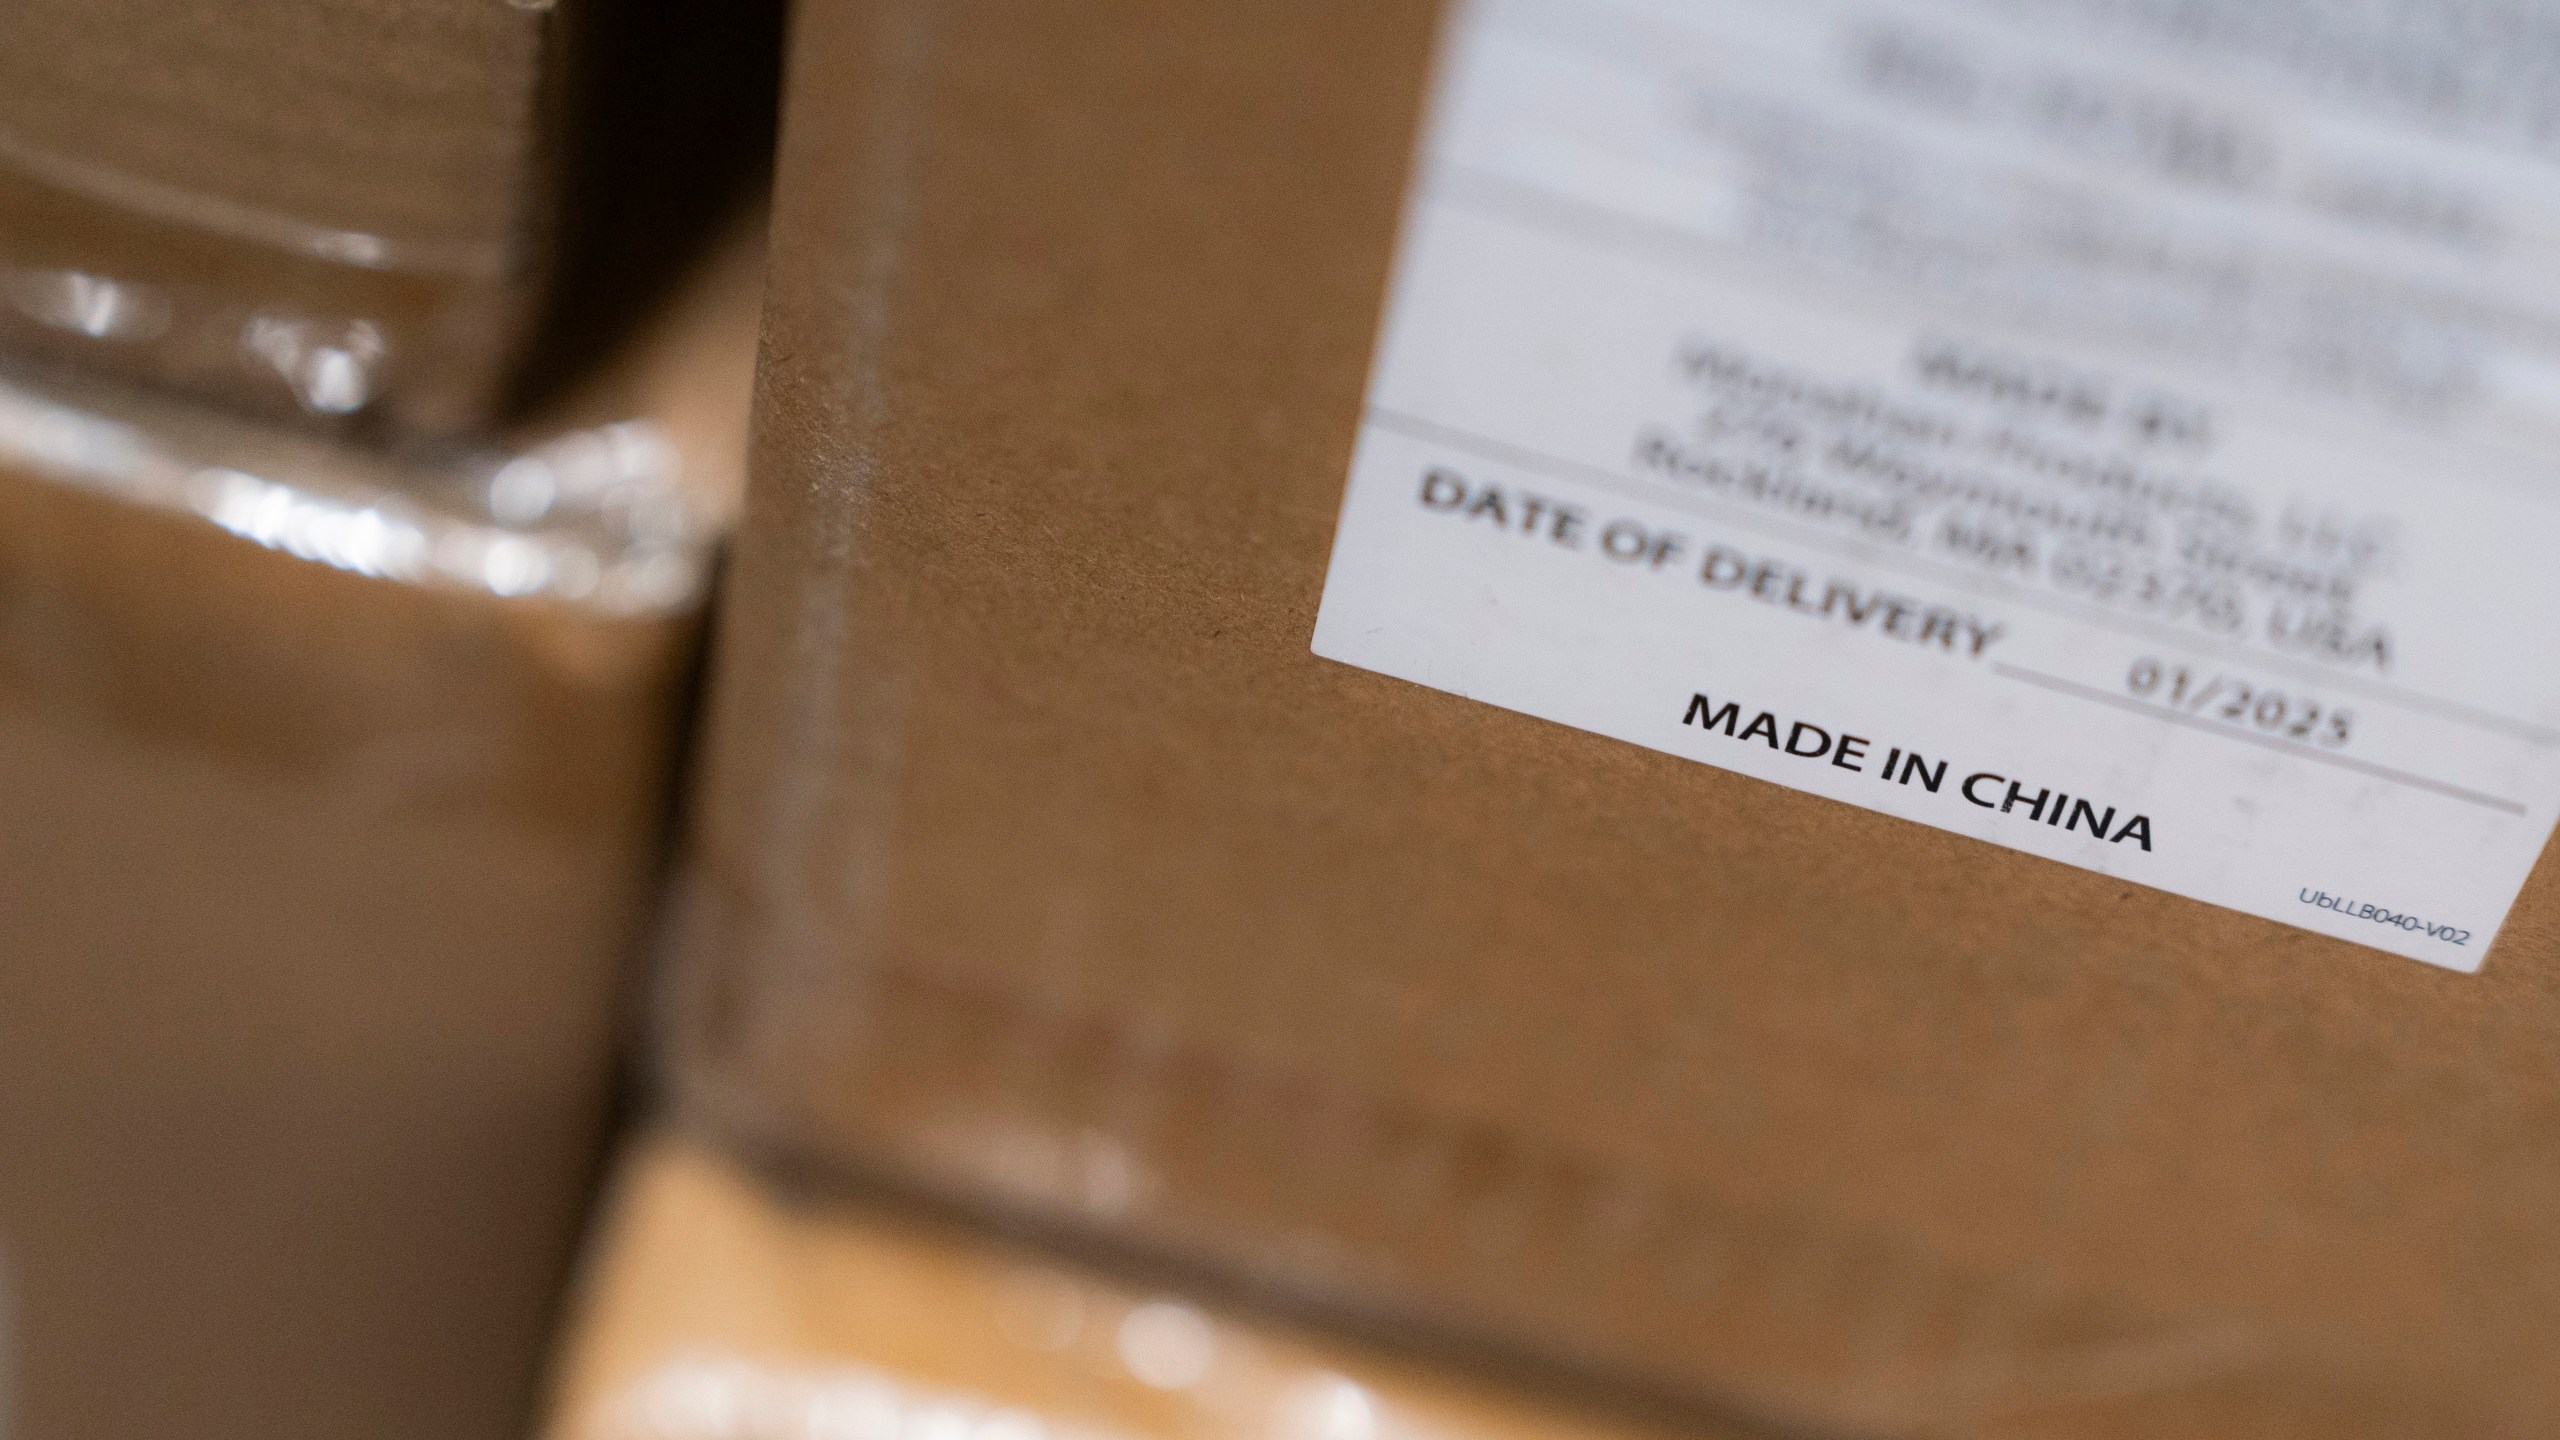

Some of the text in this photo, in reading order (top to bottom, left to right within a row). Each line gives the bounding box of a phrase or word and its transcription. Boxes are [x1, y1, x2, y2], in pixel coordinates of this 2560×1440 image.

[1418, 465, 2353, 750] DATE OF DELIVERY 01/2025
[1682, 693, 2153, 853] MADE IN CHINA
